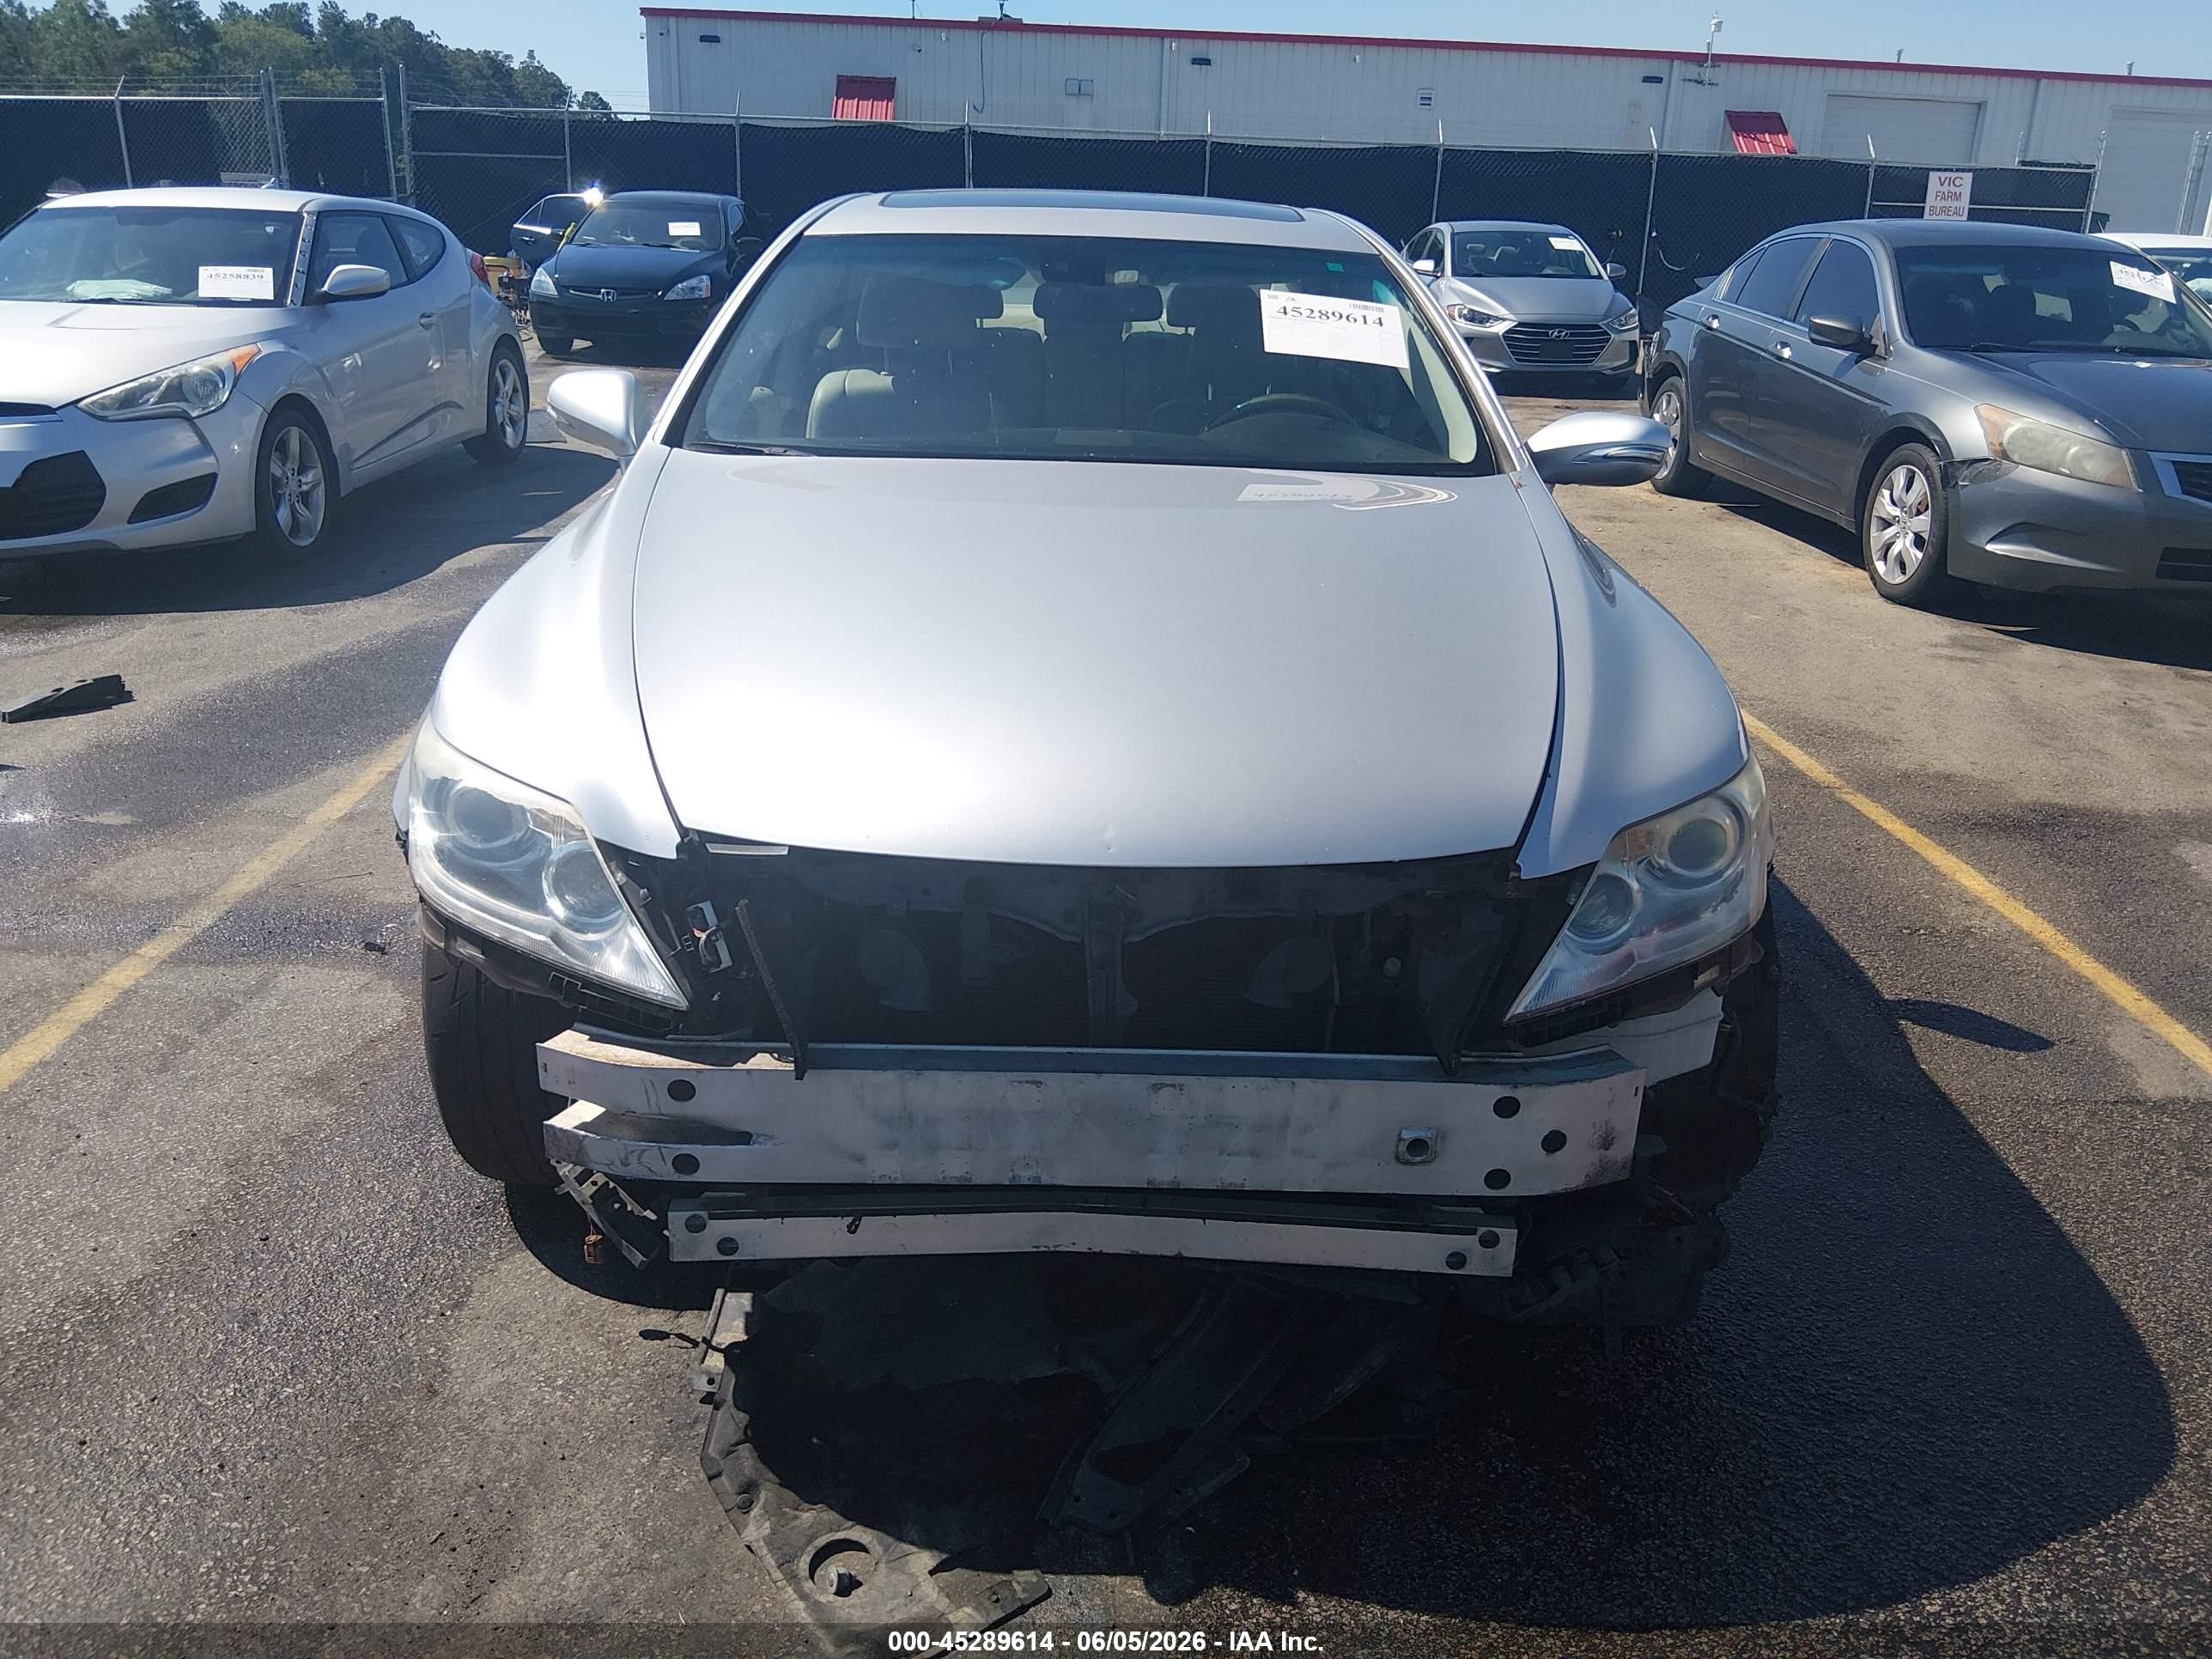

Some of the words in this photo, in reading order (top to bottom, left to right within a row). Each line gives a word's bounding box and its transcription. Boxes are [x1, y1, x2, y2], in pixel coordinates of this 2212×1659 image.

[1938, 176, 1964, 187] VIC
[1935, 191, 1962, 203] FARM
[1929, 205, 1965, 217] BUREAU
[1276, 306, 1384, 327] 45289614
